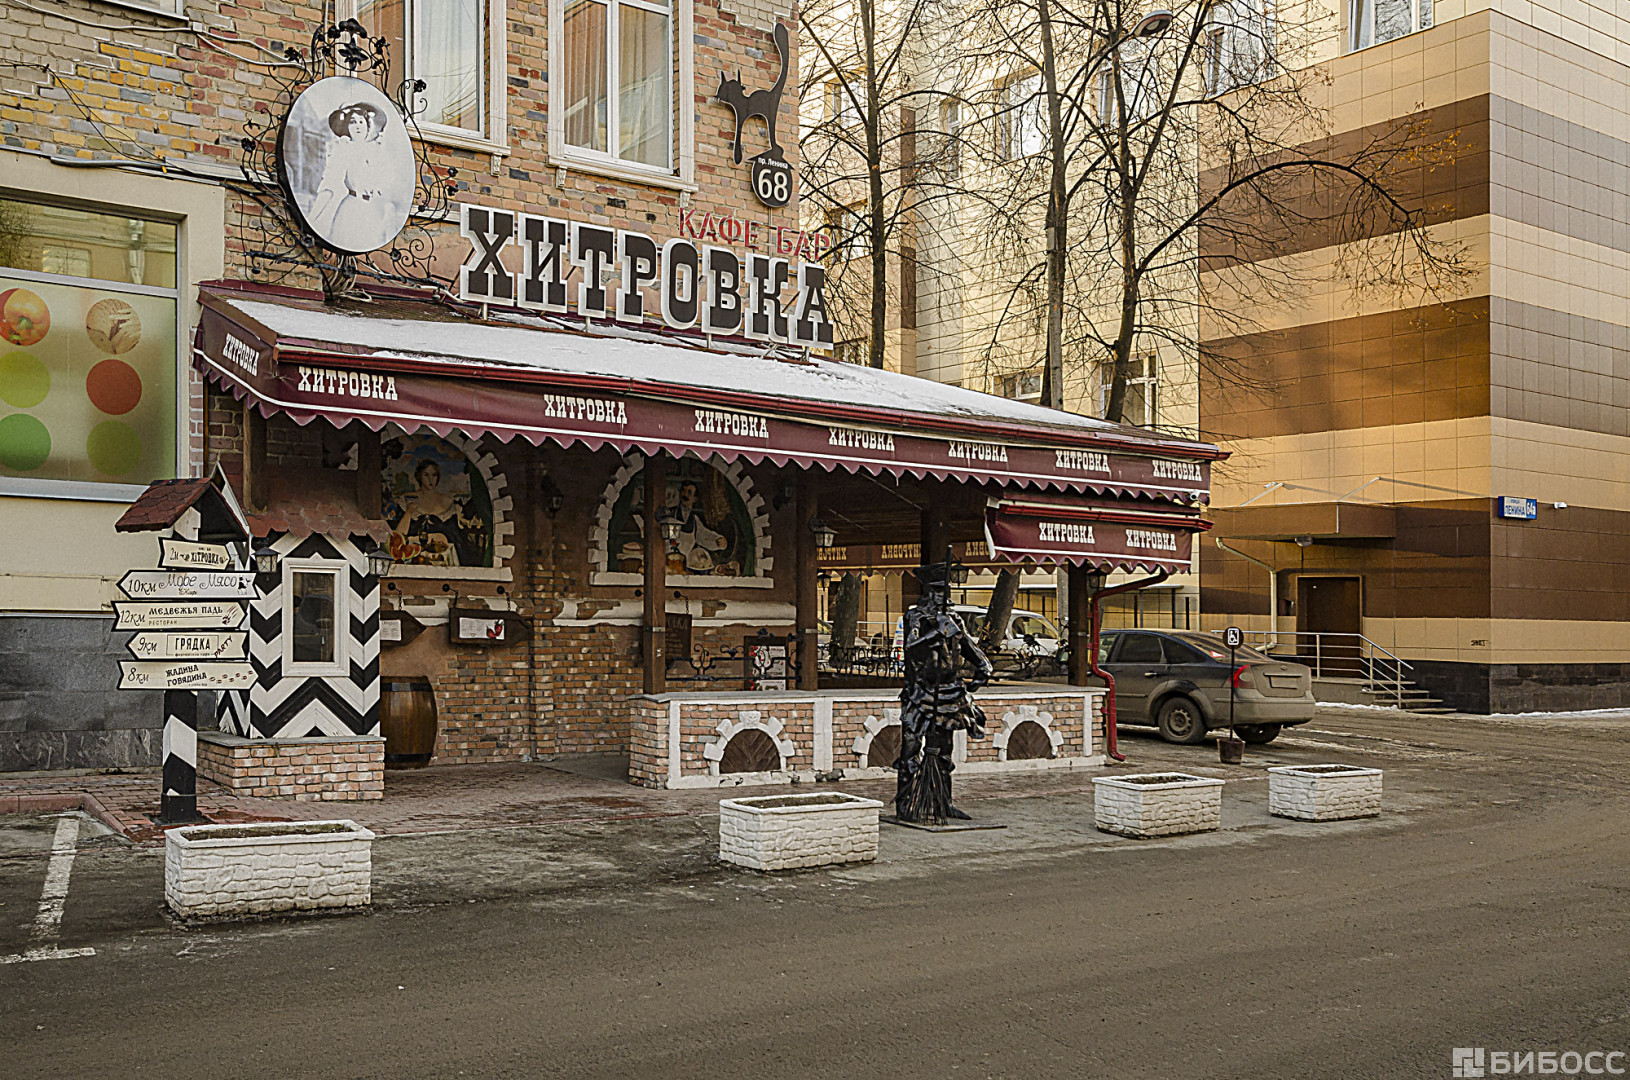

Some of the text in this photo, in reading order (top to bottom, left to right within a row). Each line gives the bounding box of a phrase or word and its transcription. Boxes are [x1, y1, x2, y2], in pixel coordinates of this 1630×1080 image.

[767, 158, 789, 170] Ленина
[758, 168, 788, 202] 68
[679, 206, 831, 261] КАФЕ БАР
[460, 203, 834, 350] ХИТРОВКА
[221, 333, 259, 377] ХИТРОВКА
[298, 366, 398, 400] ХИТРОВКА
[543, 394, 628, 424] ХИТРОВКА
[694, 409, 769, 438] ХИТРОВКА
[828, 427, 896, 451] ХИТРОВКА
[948, 440, 1008, 463] ХИТРОВКА
[1055, 450, 1110, 472] ХИТРОВКА
[1152, 460, 1203, 481] ХИТРОВКА
[1039, 522, 1096, 544] ХИТРОВКА
[1125, 529, 1177, 551] ХИТРОВКА
[127, 578, 157, 596] 10км
[199, 573, 237, 590] Мясо
[119, 606, 223, 626] 12км МЕДВЕЖЬЯ ПАДЬ
[137, 636, 211, 655] 9км ГРЯДКА
[213, 635, 233, 659] PARTY
[127, 664, 199, 685] 8км ЖАДИНА
[167, 672, 208, 687] ГОВЯДИНА
